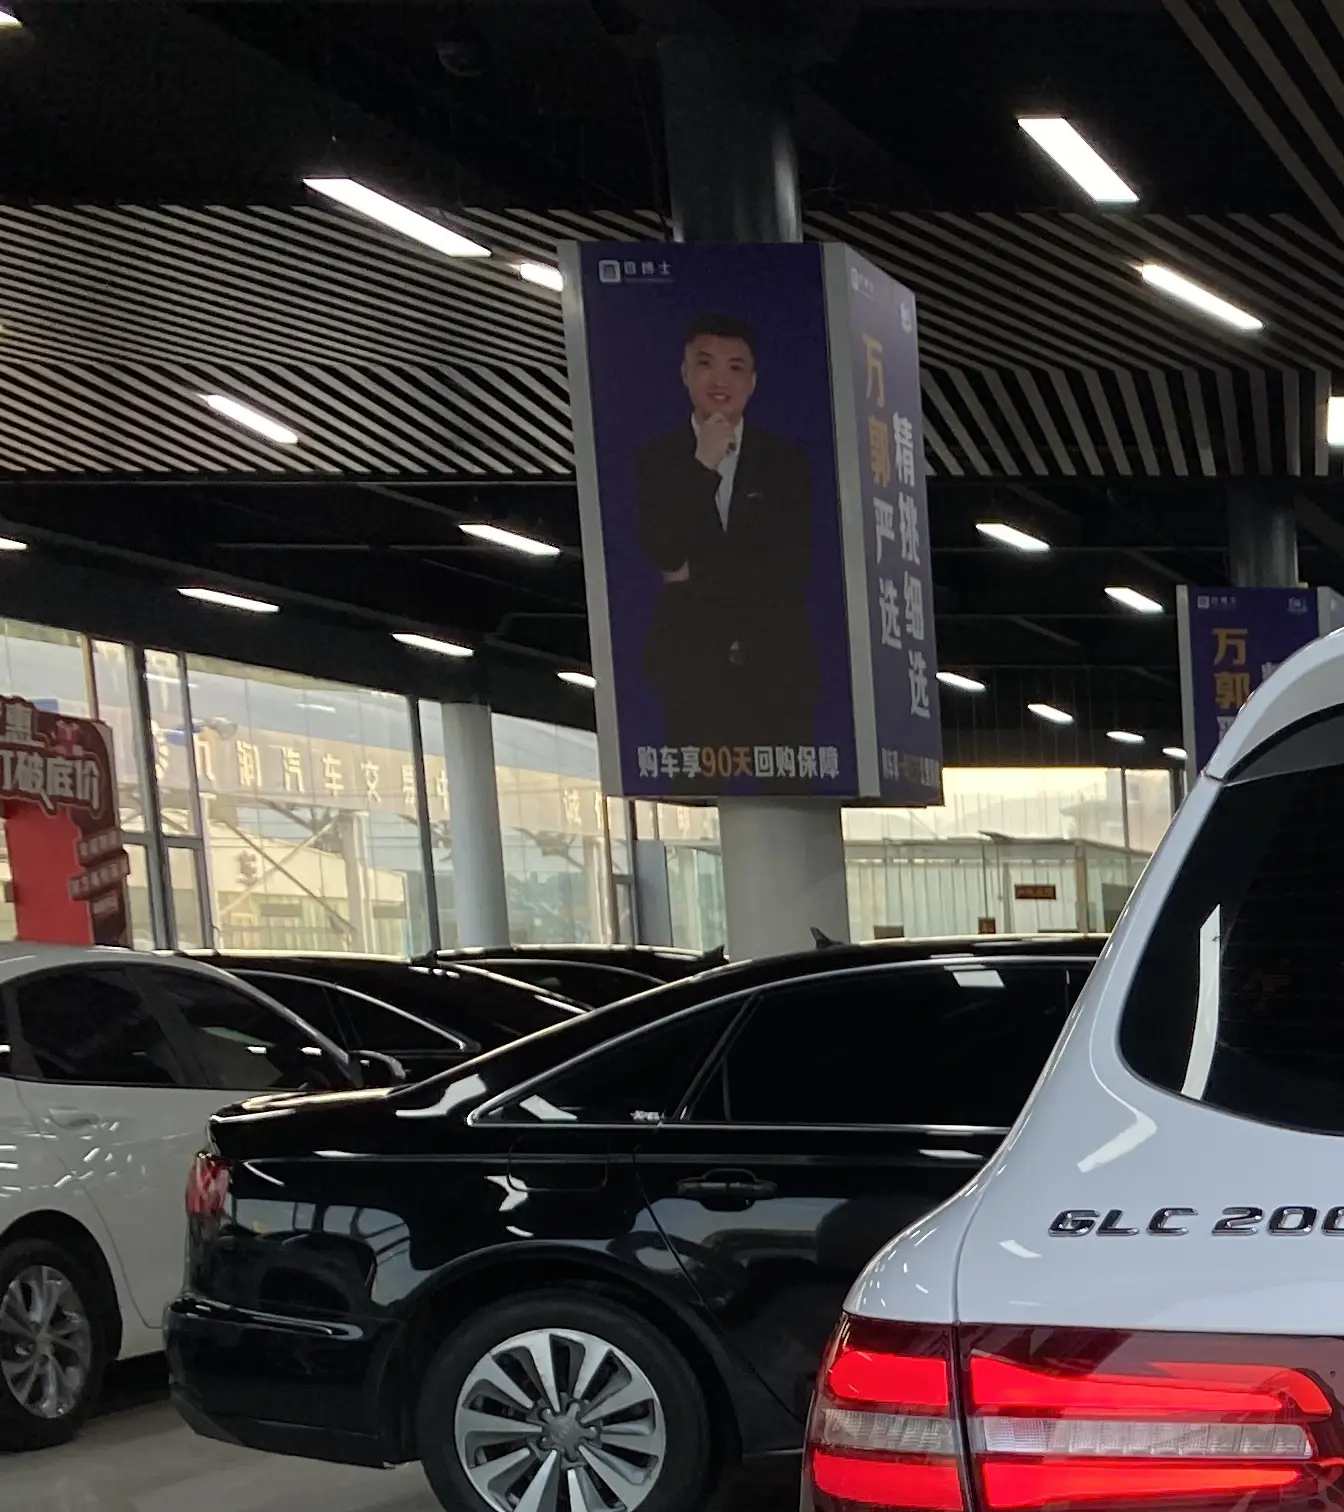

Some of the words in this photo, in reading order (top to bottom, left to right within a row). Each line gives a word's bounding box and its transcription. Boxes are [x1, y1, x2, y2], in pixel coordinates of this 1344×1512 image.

[862, 333, 902, 651] 万郭严选
[892, 411, 931, 719] 精挑细选
[637, 746, 840, 780] 购车享90天回购保障
[1048, 1208, 1198, 1237] GLC
